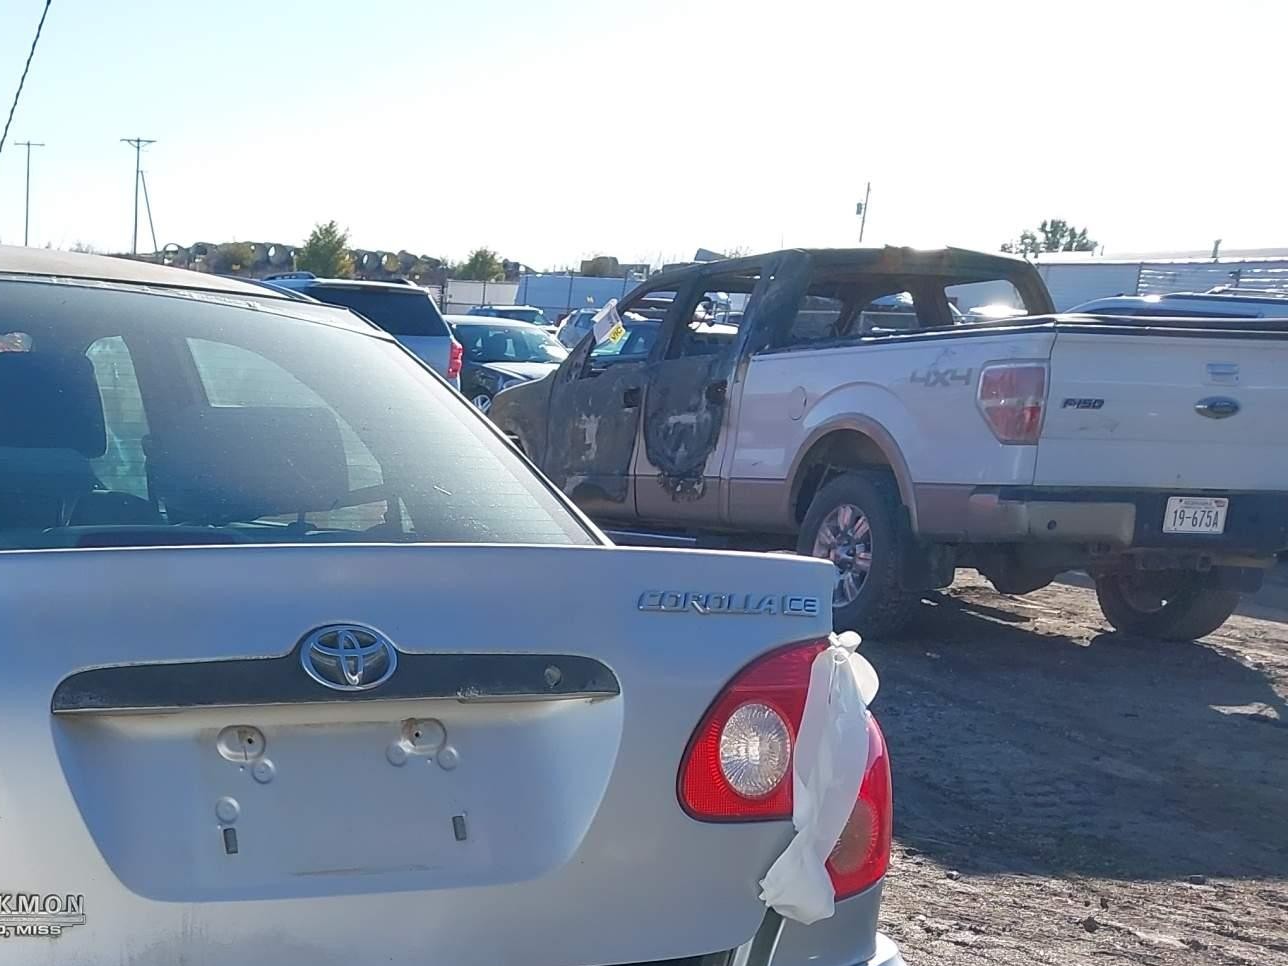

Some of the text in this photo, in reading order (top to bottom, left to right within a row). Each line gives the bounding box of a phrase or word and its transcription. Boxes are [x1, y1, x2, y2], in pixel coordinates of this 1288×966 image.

[1172, 509, 1219, 529] 19-675A
[637, 590, 819, 616] COROLLA CE
[15, 924, 62, 937] MISS
